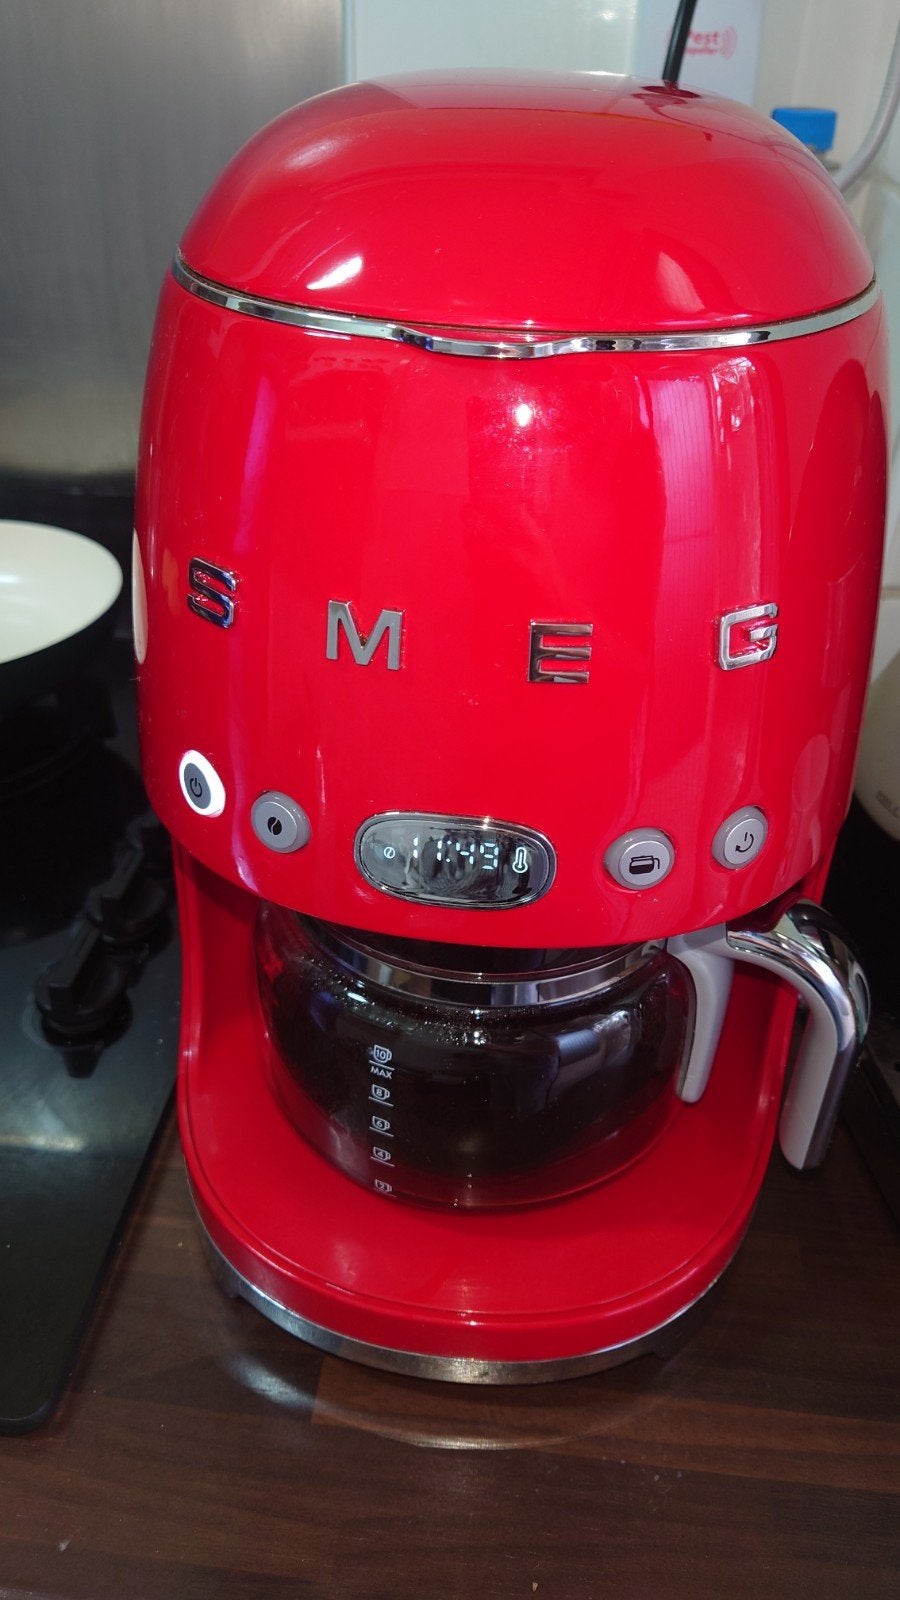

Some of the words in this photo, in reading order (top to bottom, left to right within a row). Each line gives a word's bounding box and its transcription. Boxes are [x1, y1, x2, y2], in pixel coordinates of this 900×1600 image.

[187, 556, 780, 685] SMEG
[412, 837, 499, 870] 11:49
[370, 1065, 393, 1080] MAX
